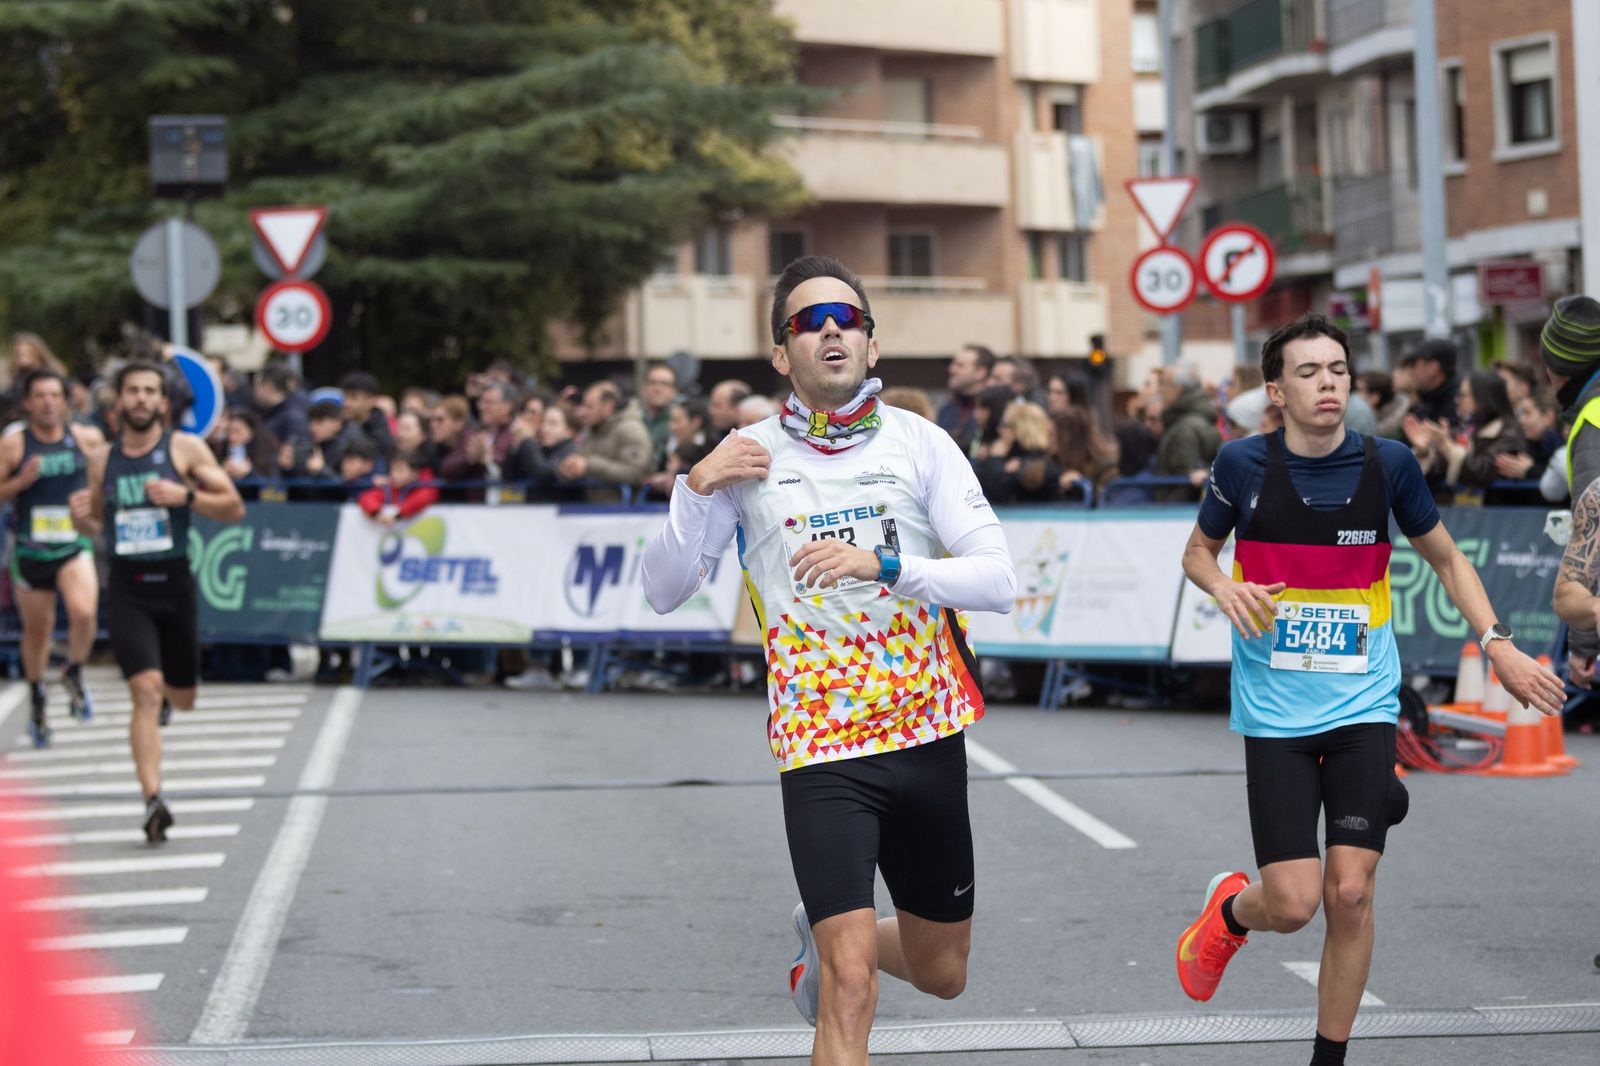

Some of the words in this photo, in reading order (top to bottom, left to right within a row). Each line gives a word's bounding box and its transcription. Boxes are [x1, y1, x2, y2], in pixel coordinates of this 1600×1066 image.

[1146, 267, 1184, 292] 30
[275, 303, 314, 330] 30
[809, 505, 883, 529] SETEL
[1337, 529, 1377, 545] 226ERS
[399, 556, 500, 583] SETEL
[1301, 607, 1360, 620] SETEL
[1285, 620, 1347, 650] 5484
